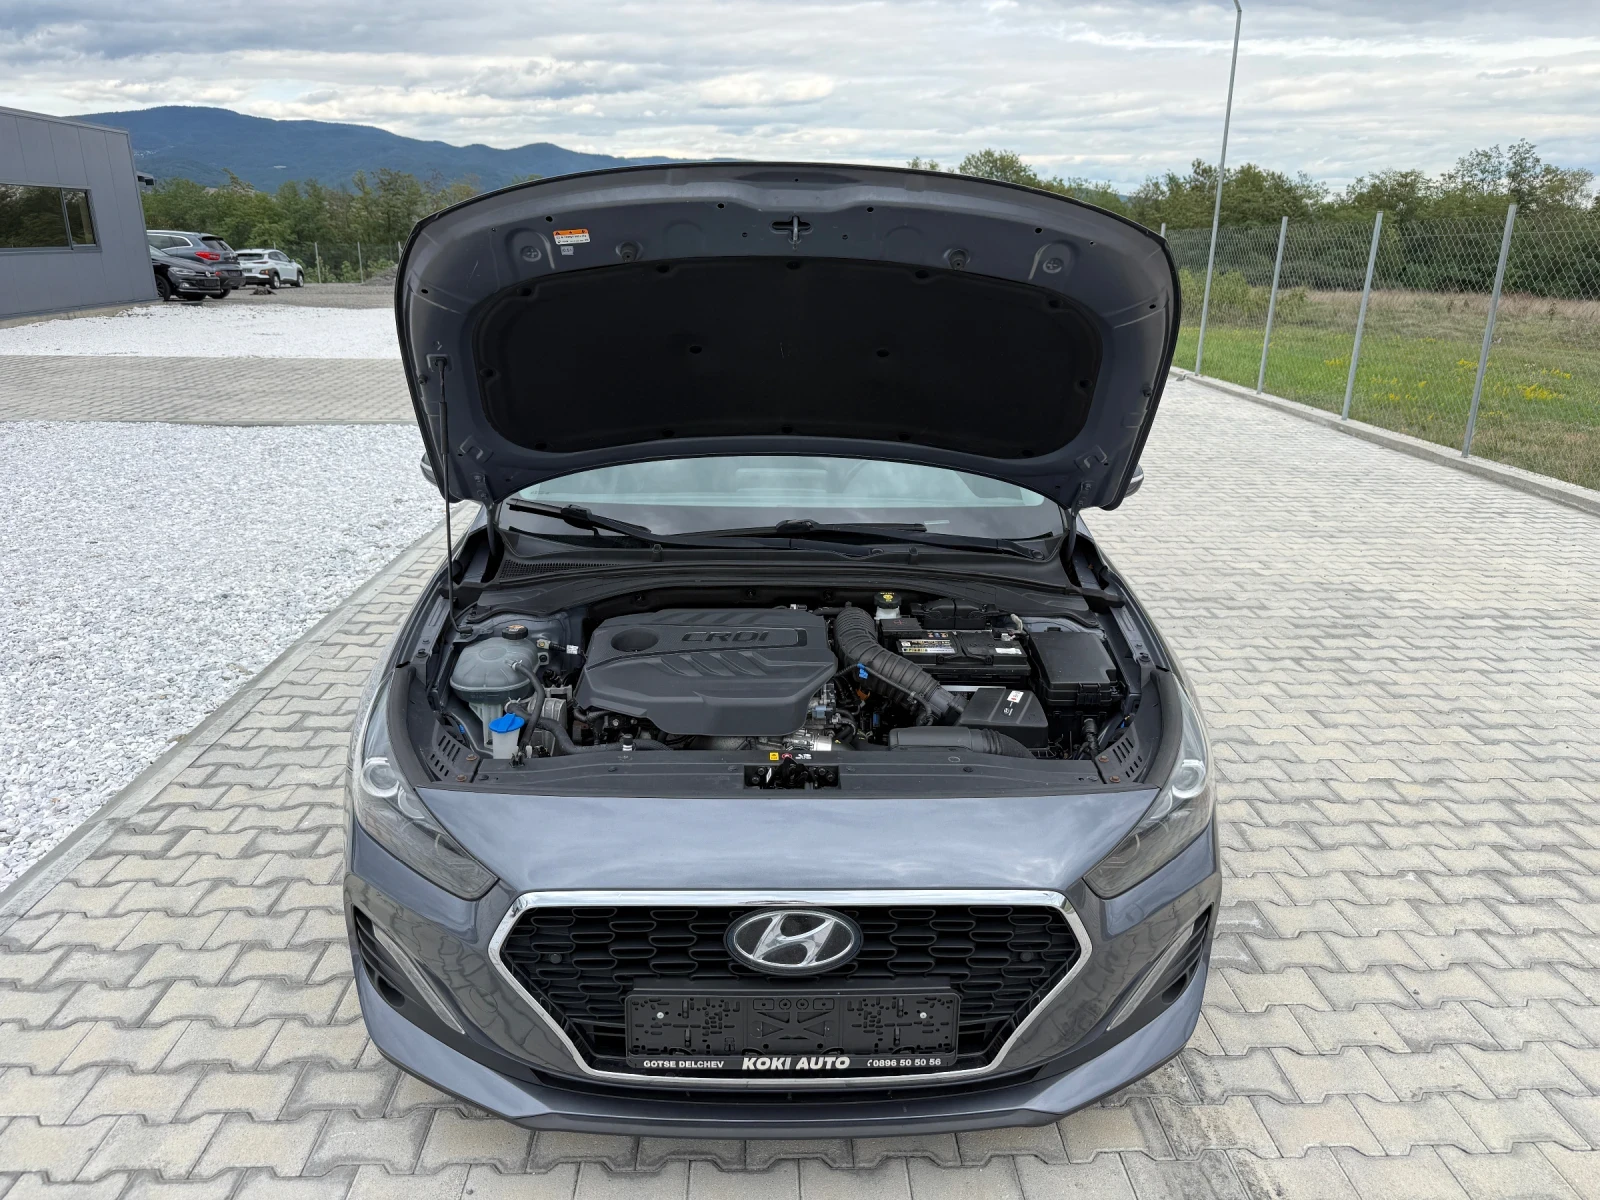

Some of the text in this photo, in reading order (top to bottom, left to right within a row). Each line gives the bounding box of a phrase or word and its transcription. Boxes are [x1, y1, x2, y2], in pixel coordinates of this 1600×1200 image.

[681, 631, 769, 642] CRDI
[643, 1060, 725, 1068] GOTSE DELCHEV
[741, 1056, 850, 1070] KOKI AUTO
[872, 1058, 942, 1067] 0896 50 50 56
